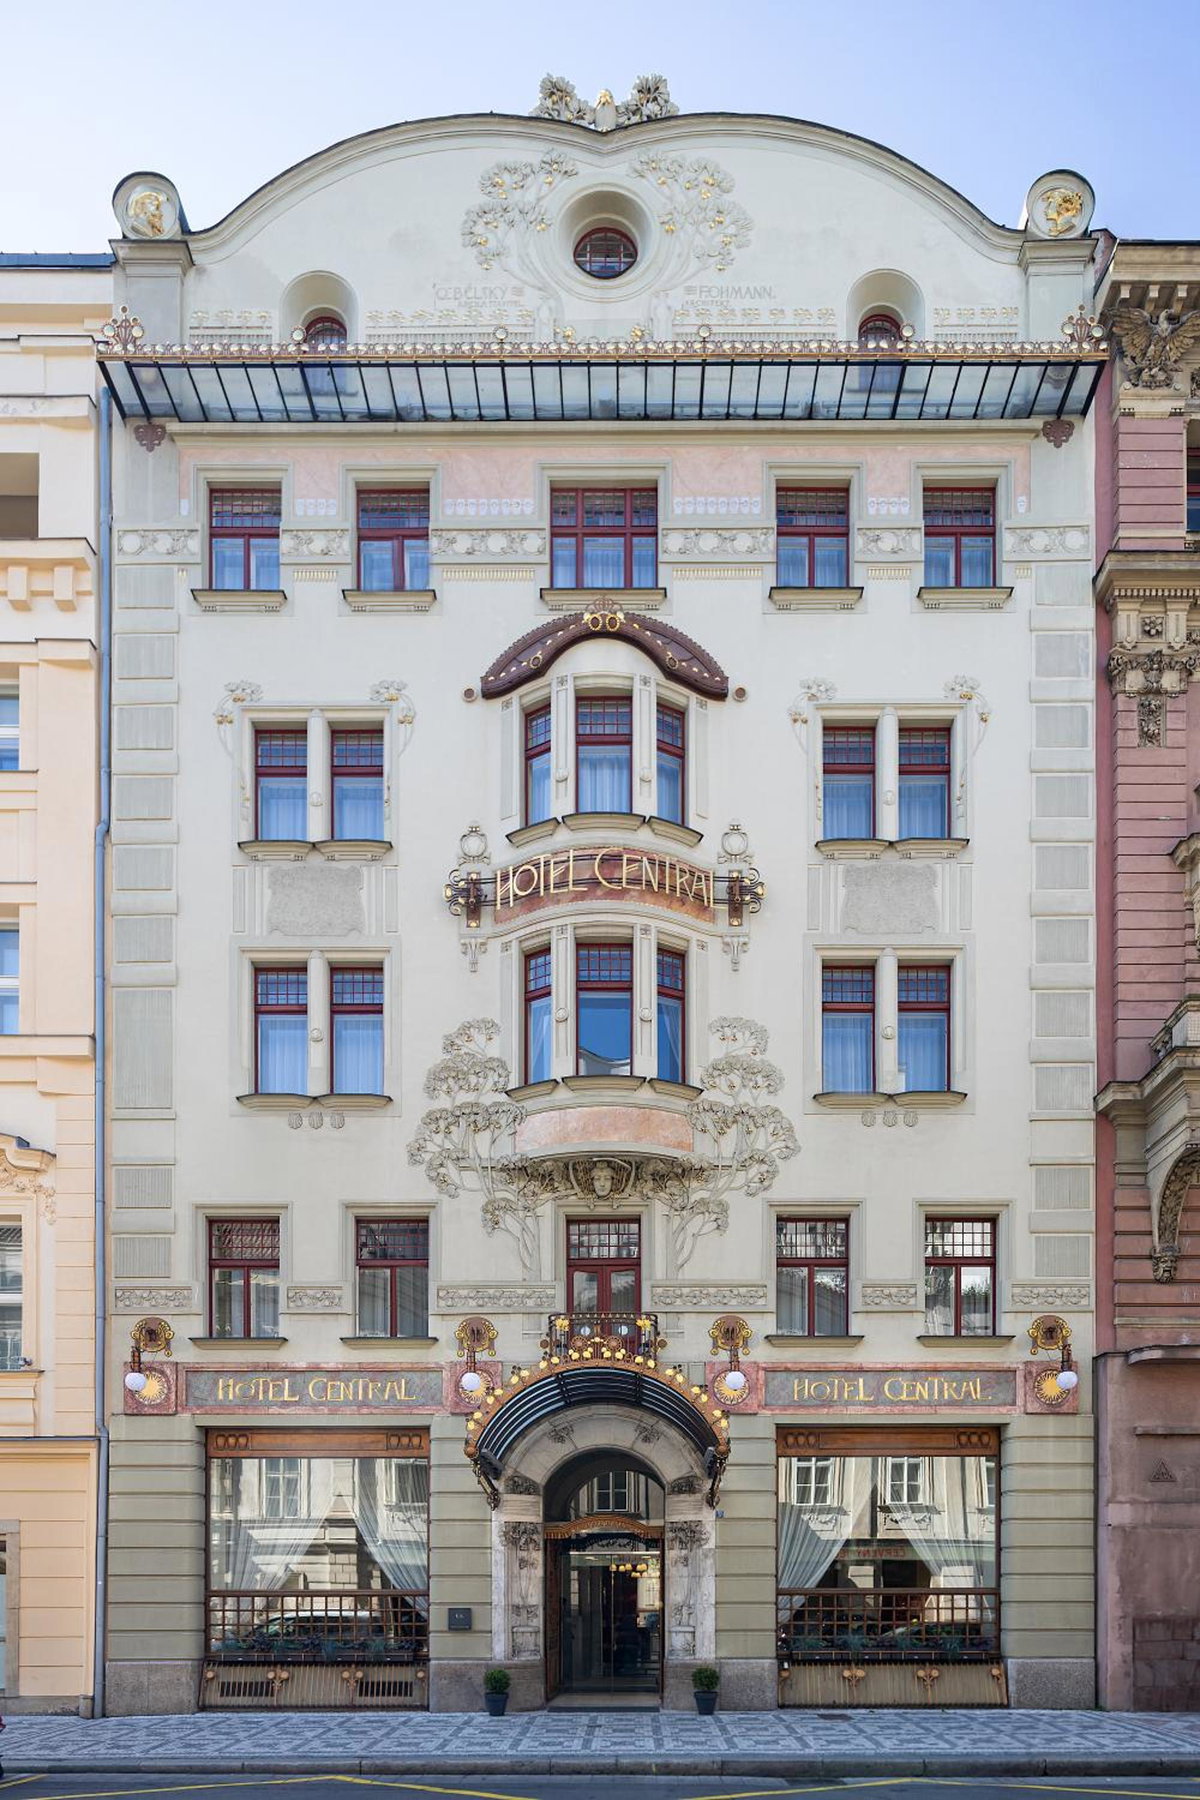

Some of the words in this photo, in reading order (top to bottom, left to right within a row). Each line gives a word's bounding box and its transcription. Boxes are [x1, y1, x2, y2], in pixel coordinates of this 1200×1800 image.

[496, 849, 588, 910] HOTEL
[594, 847, 728, 909] CENTRAL
[218, 1378, 300, 1401] HOTEL
[793, 1377, 874, 1401] HOTEL
